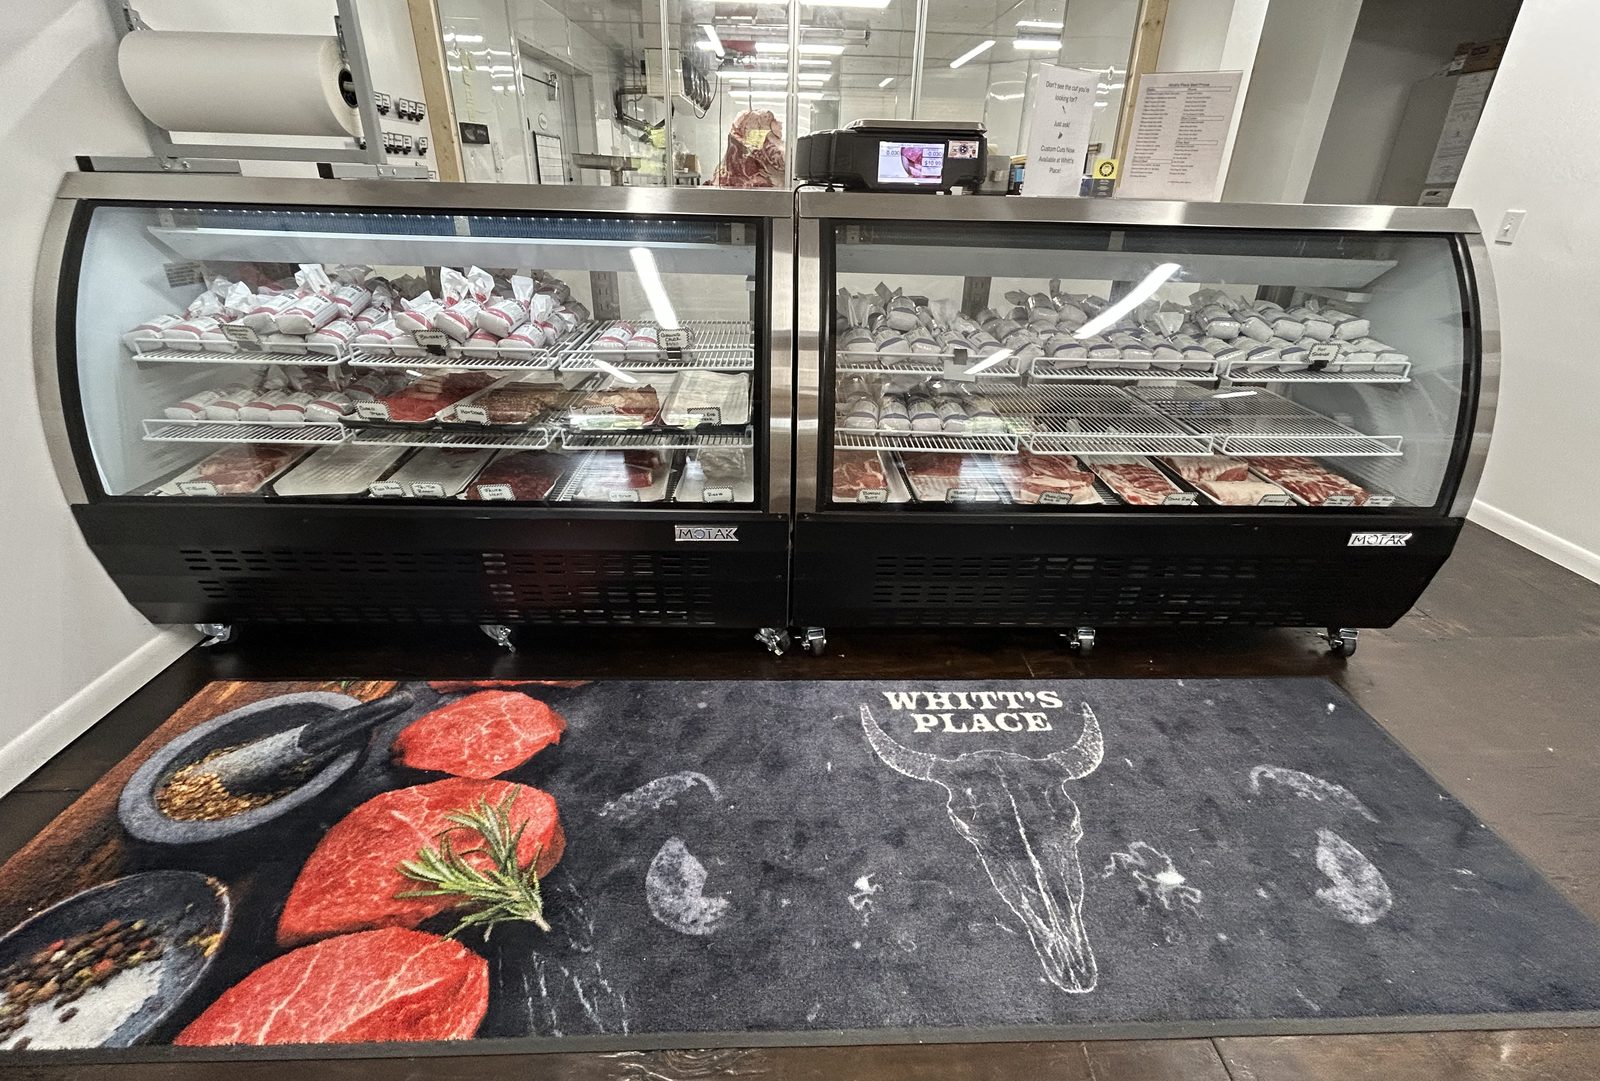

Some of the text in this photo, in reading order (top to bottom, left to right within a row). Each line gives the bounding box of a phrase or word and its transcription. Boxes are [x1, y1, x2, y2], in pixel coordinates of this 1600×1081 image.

[1046, 80, 1057, 88] Don't
[1055, 94, 1069, 103] looking
[1040, 144, 1056, 152] Custom
[678, 528, 735, 540] MOTAK
[1350, 534, 1407, 545] MOTAK
[882, 690, 1064, 711] WHITT'S
[911, 711, 1053, 733] PLACE
